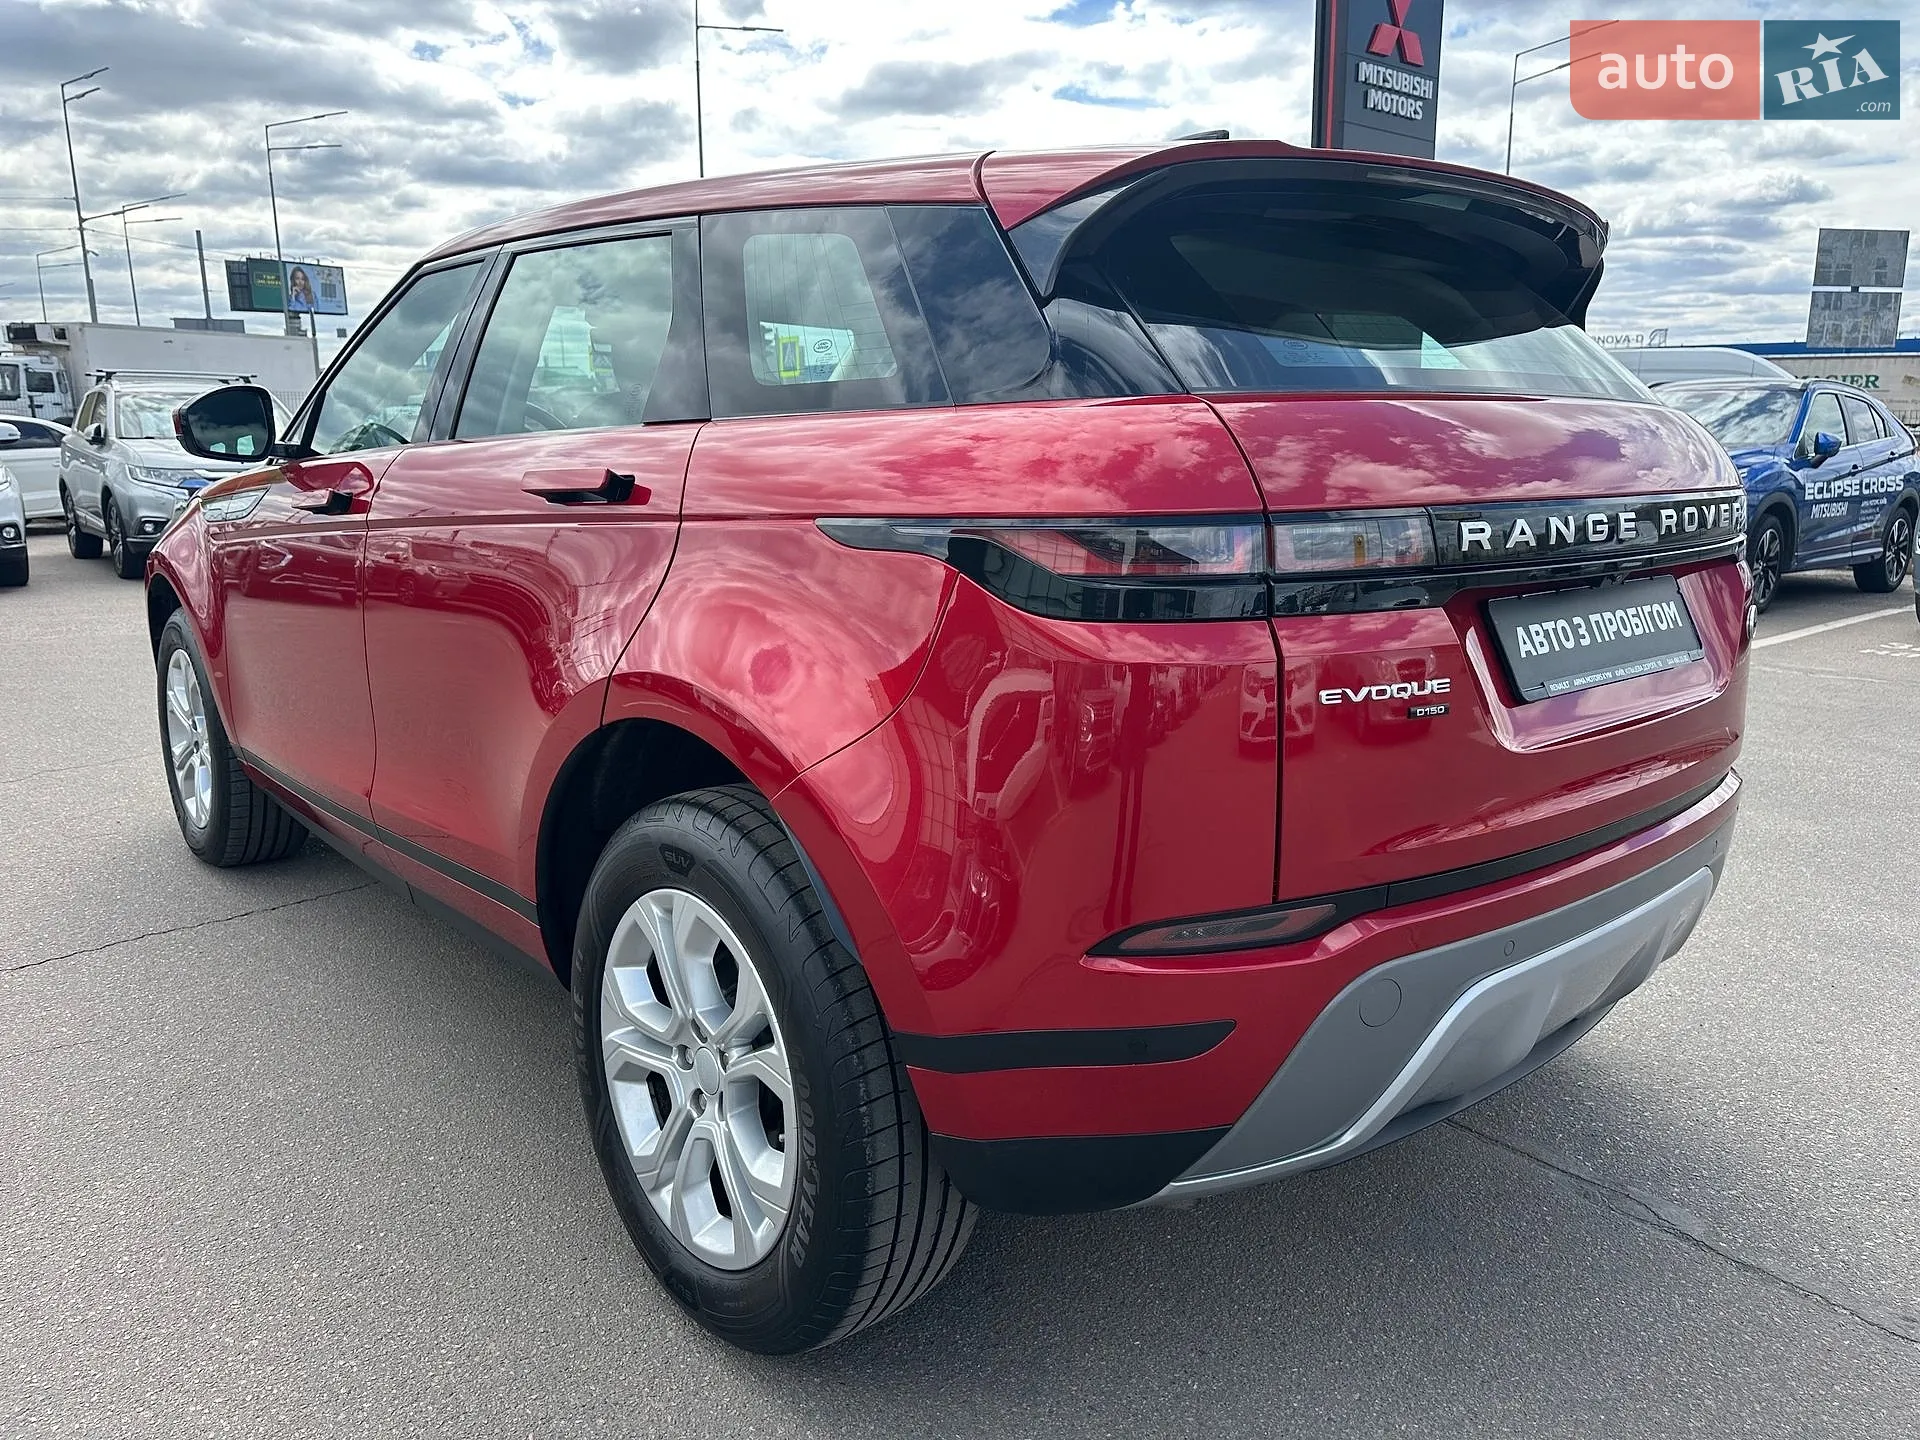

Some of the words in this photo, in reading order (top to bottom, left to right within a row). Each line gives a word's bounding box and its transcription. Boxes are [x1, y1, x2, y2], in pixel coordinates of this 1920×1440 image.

[1358, 61, 1433, 99] MITSUBISHI
[1366, 88, 1423, 120] MOTORS
[1805, 479, 1860, 500] ECLIPSE
[1862, 474, 1904, 495] CROSS
[1810, 501, 1849, 519] MITSUBISHI
[1460, 511, 1637, 551] RANGE
[1660, 502, 1743, 535] ROVER
[1516, 618, 1575, 659] АВТО
[1572, 616, 1591, 647] З
[1588, 601, 1683, 644] ПРОБІГОМ
[1319, 678, 1451, 705] EVOQUE
[1416, 705, 1445, 717] D150
[664, 850, 690, 868] SUV
